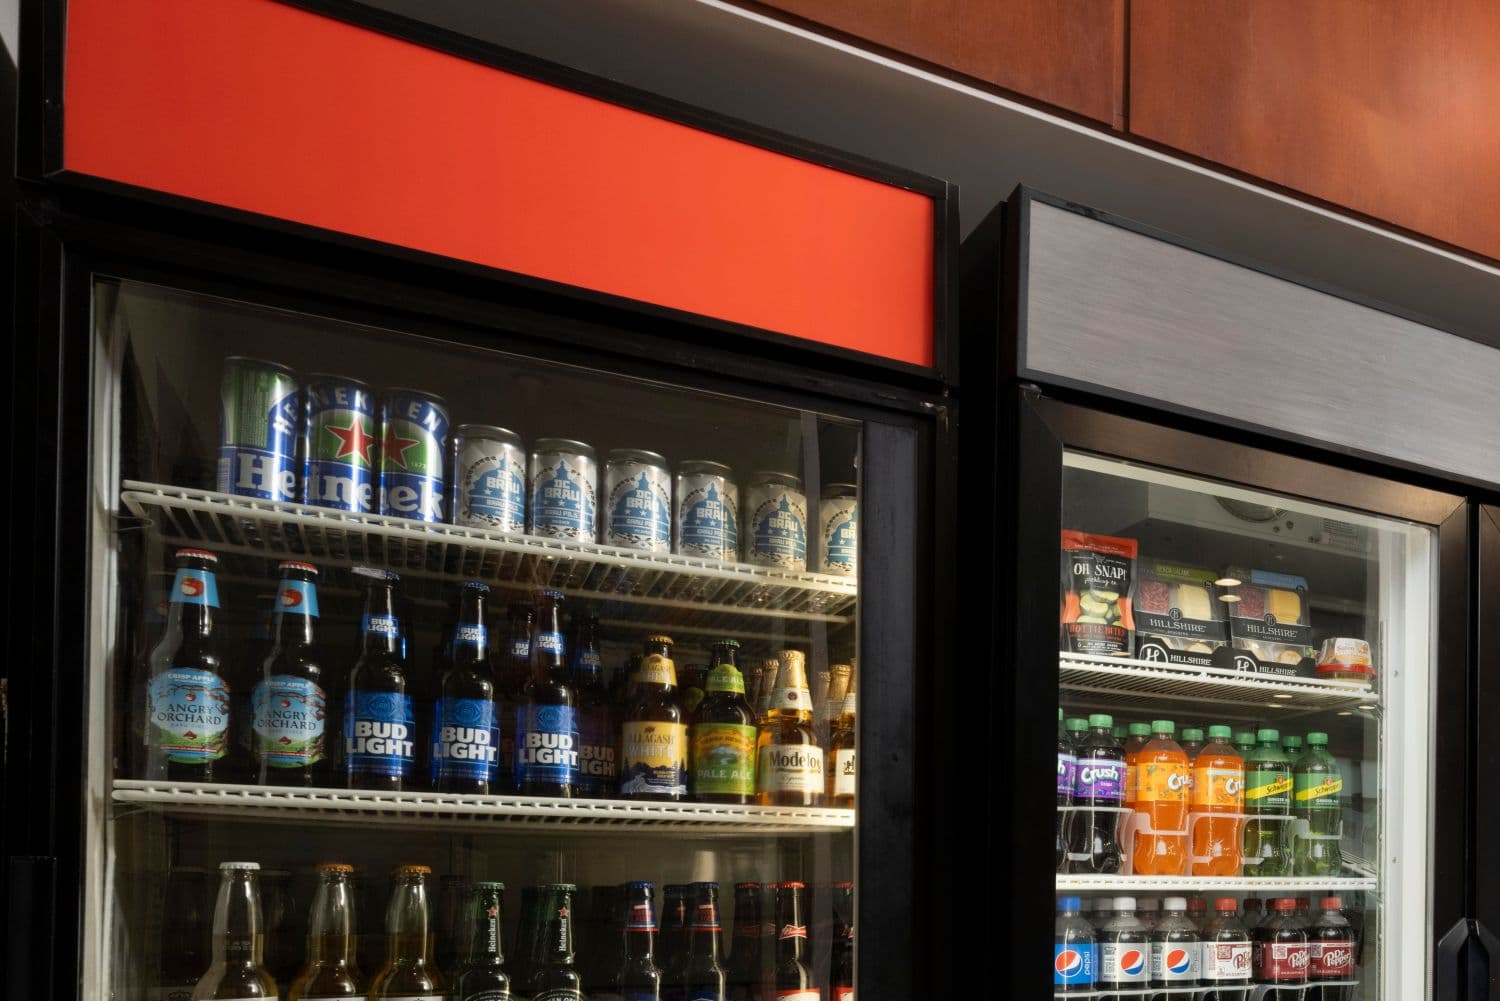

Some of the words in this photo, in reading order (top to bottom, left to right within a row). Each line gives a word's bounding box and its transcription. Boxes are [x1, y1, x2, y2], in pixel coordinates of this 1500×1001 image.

[1073, 562, 1091, 576] OH
[1094, 563, 1127, 580] SNAP!
[366, 623, 399, 635] LIGHT
[371, 617, 396, 626] BUD
[1150, 618, 1207, 633] HILLSHIRE
[460, 626, 482, 635] BUD
[1247, 623, 1298, 638] HILLSHIRE
[538, 634, 557, 643] BUD
[1170, 653, 1212, 666] HILLSHIRE
[167, 702, 216, 715] ANGRY
[262, 709, 309, 721] ANGRY
[157, 711, 222, 725] ORCHARD
[257, 718, 317, 731] ORCHARD
[355, 721, 408, 739] BUD
[440, 727, 491, 745] BUD
[346, 737, 414, 758] LIGHT
[526, 732, 574, 749] BUD
[434, 743, 498, 763] LIGHT
[520, 748, 579, 765] LIGHT
[697, 769, 729, 781] PALE
[1081, 766, 1119, 784] Crush
[488, 918, 496, 952] Heineken
[559, 918, 567, 952] Heineken
[1323, 953, 1351, 968] Pepper
